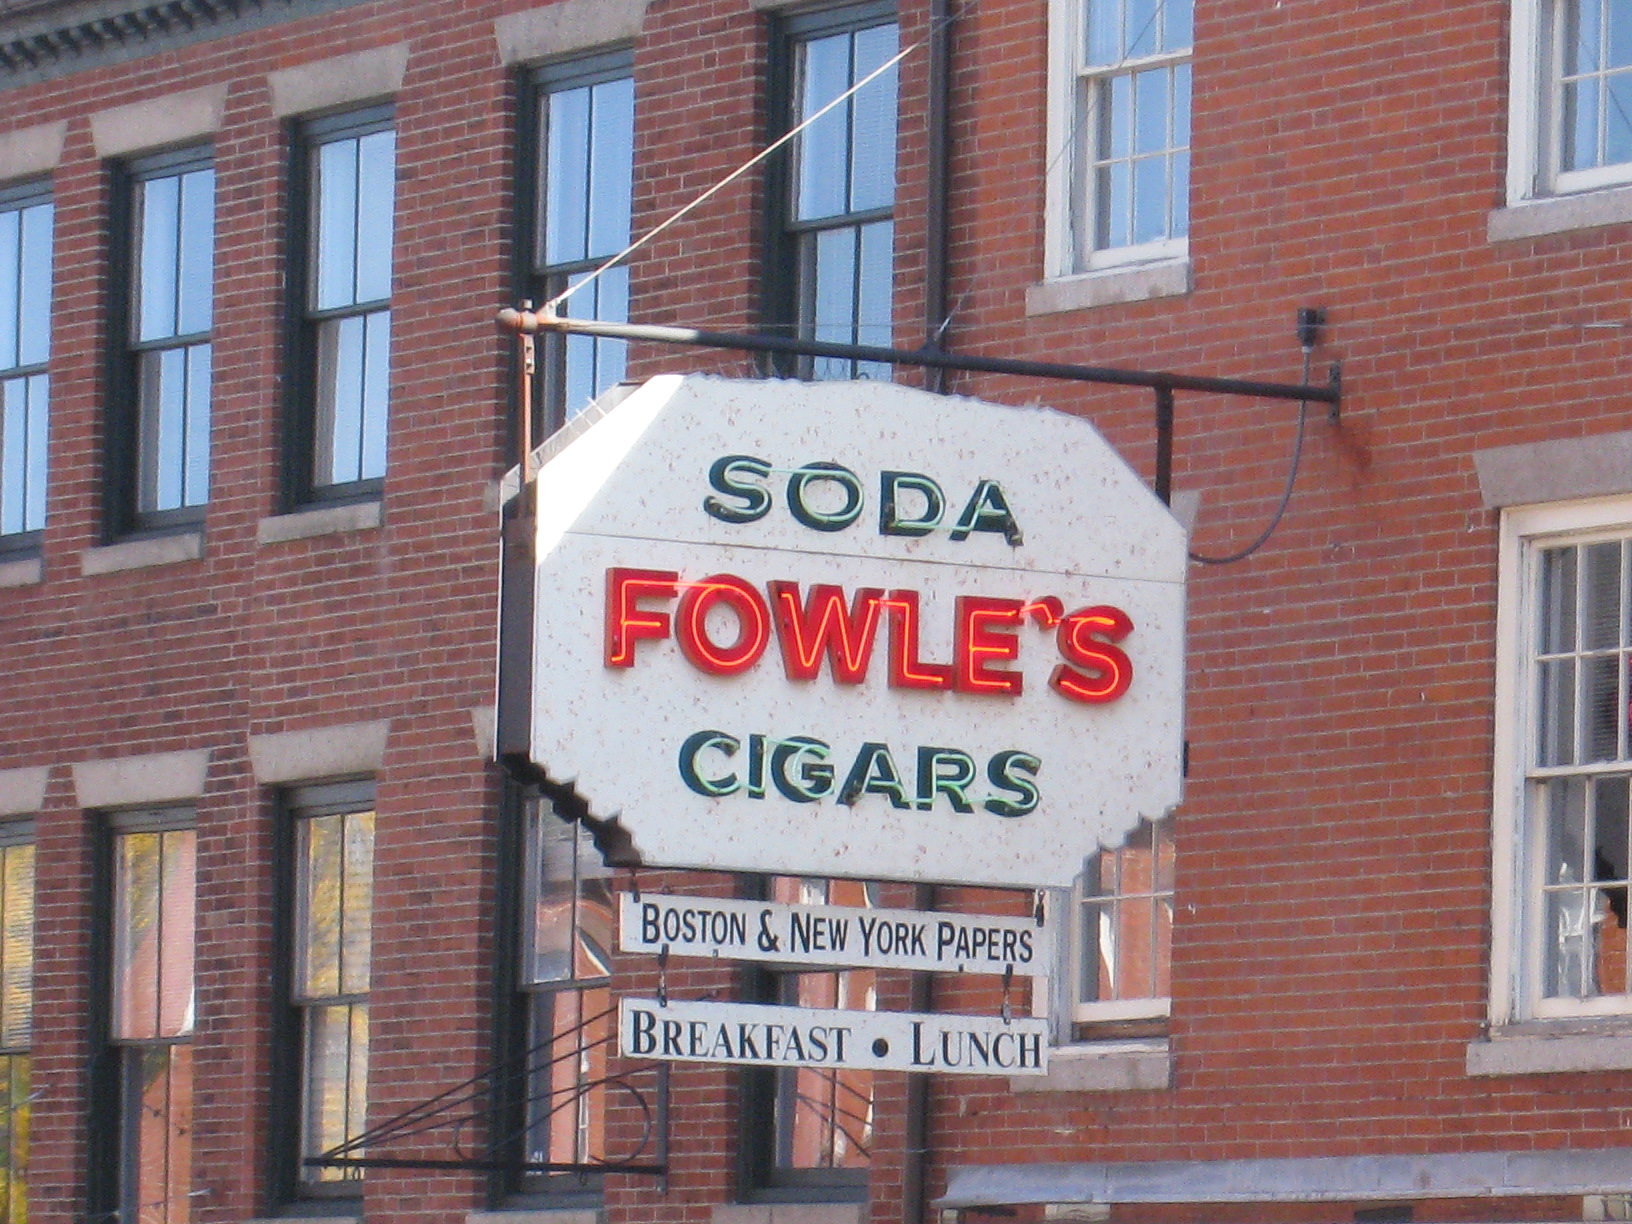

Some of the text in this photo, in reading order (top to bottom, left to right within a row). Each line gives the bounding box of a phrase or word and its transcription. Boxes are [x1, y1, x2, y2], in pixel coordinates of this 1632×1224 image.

[703, 454, 1024, 546] SODA
[605, 566, 1135, 704] FOWLE'S
[678, 730, 1041, 817] CIGARS
[642, 903, 1033, 963] BOSTON & NEW YORK PAPERS
[631, 1008, 1042, 1068] BREAKFAST LUNCH
